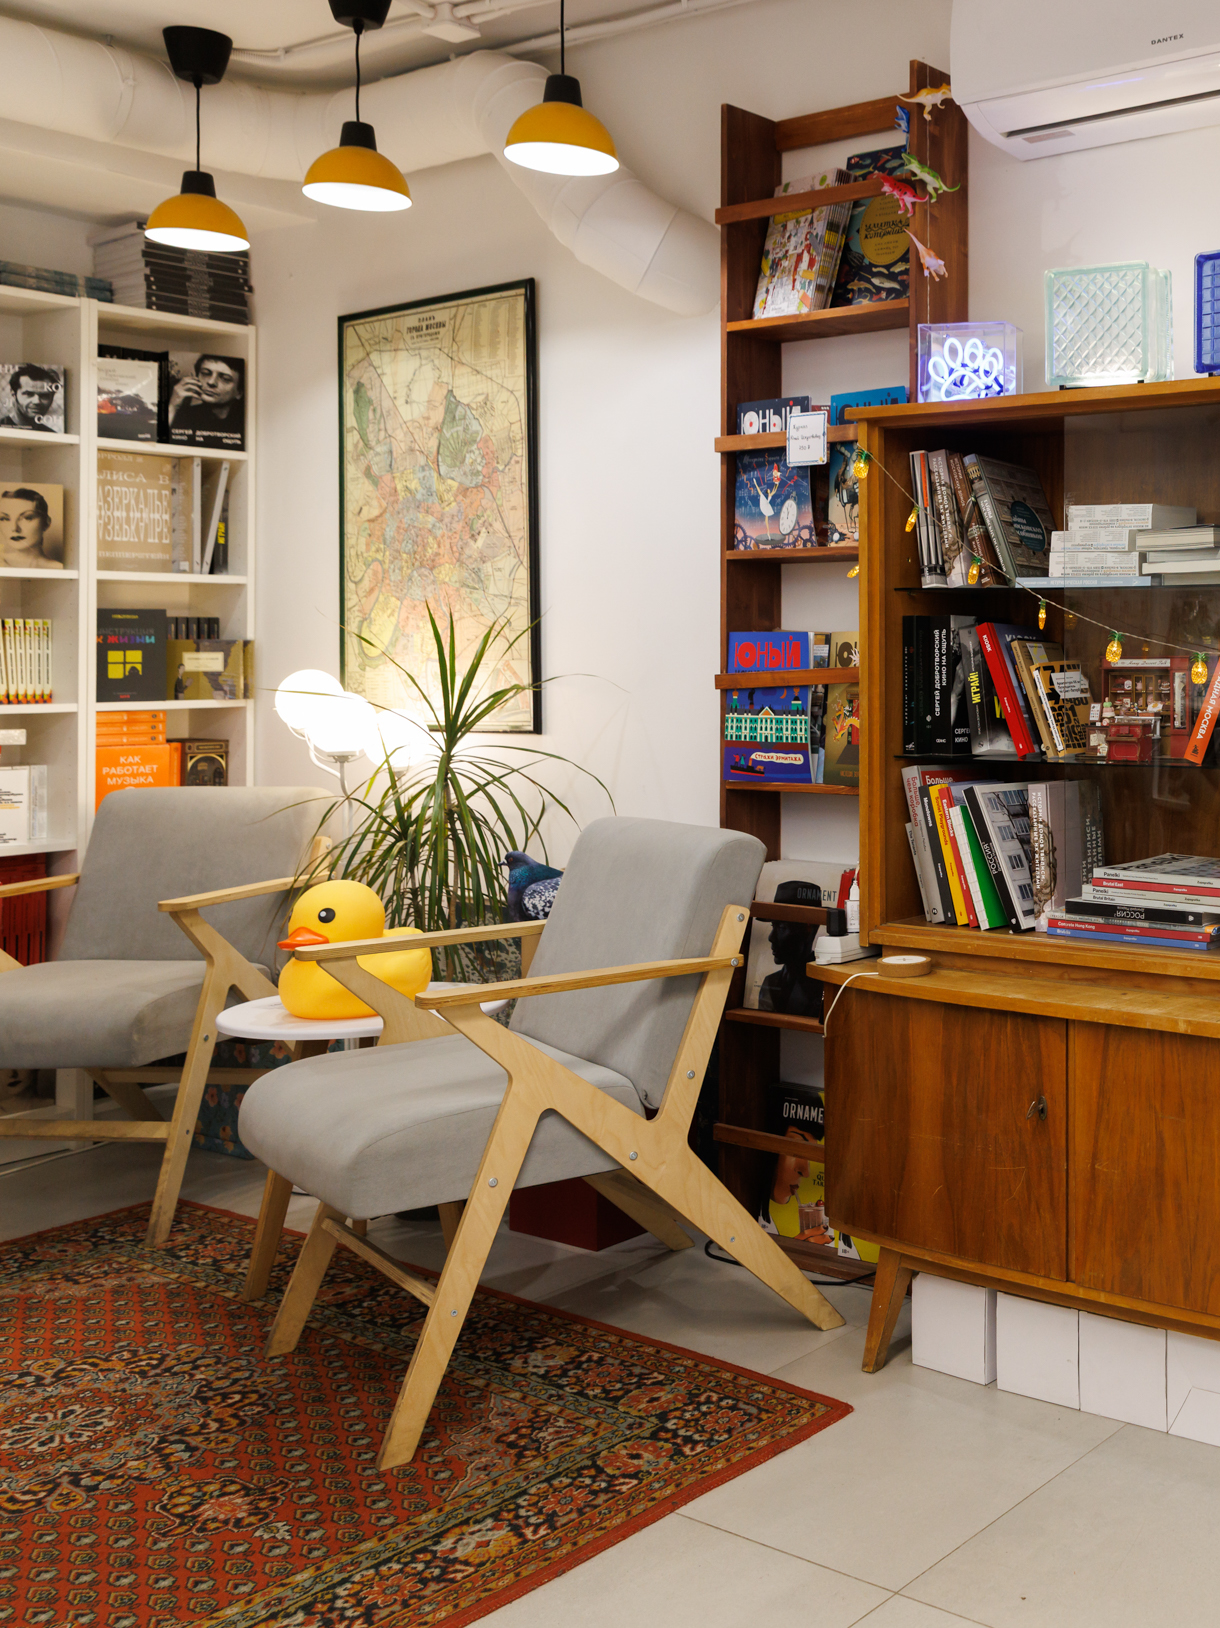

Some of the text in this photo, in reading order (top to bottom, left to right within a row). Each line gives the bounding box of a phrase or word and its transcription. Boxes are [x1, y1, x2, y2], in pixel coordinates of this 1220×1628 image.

[1150, 33, 1184, 45] DANTEX
[406, 320, 446, 334] ГОРОДА МОСКВЫ
[171, 434, 188, 442] КИНО
[195, 430, 242, 439] ДОБРОТВОРСКИЙ
[932, 458, 942, 503] РАССКАЗАННЫЕ
[937, 457, 945, 485] ИСТОРИИ
[941, 486, 949, 509] ДОМОВ
[107, 636, 155, 644] ЖИЗНИ
[982, 634, 992, 653] KIOSK
[734, 635, 801, 668] ЮНЫЙ
[933, 629, 941, 689] ДОБРОТВОРСКИЙ
[941, 655, 947, 665] НА
[967, 671, 981, 704] ИГРАЙ!
[1197, 706, 1214, 739] МОСКВА
[102, 765, 158, 775] РАБОТАЕТ
[120, 755, 141, 764] КАК
[107, 775, 154, 785] МУЗЫКА
[911, 776, 921, 808] Больше,
[908, 794, 919, 827] коробка
[923, 797, 933, 827] Monotowns
[934, 796, 949, 846] Soviet Playgrounds
[941, 799, 954, 837] Eastern Blocks
[796, 888, 837, 902] ORNAMENT
[782, 1102, 824, 1124] ORNAME
